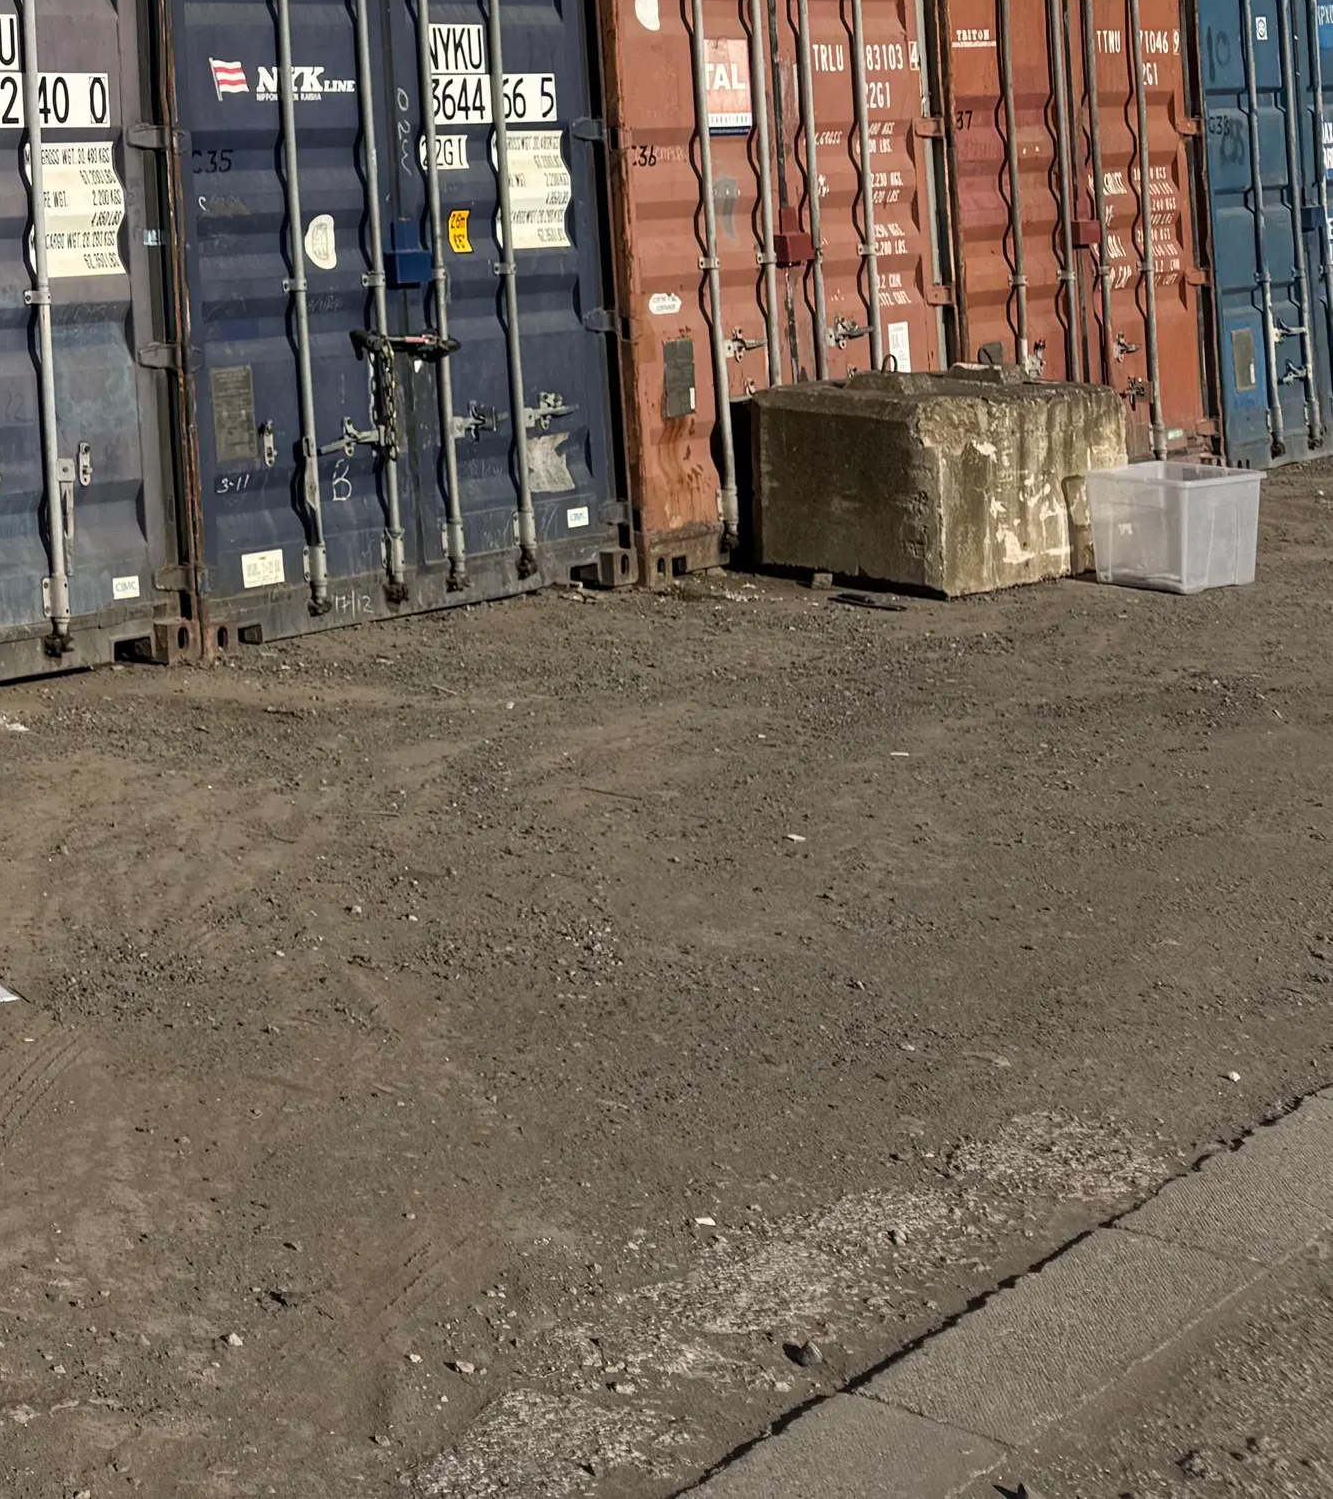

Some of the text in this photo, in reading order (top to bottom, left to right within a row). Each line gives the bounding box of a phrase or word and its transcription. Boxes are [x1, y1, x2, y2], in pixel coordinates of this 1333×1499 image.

[956, 29, 990, 41] TRITON
[812, 43, 845, 72] TRLU
[865, 43, 904, 71] 83103
[89, 76, 107, 125] 0
[323, 79, 356, 93] LINE
[541, 76, 555, 119] 5
